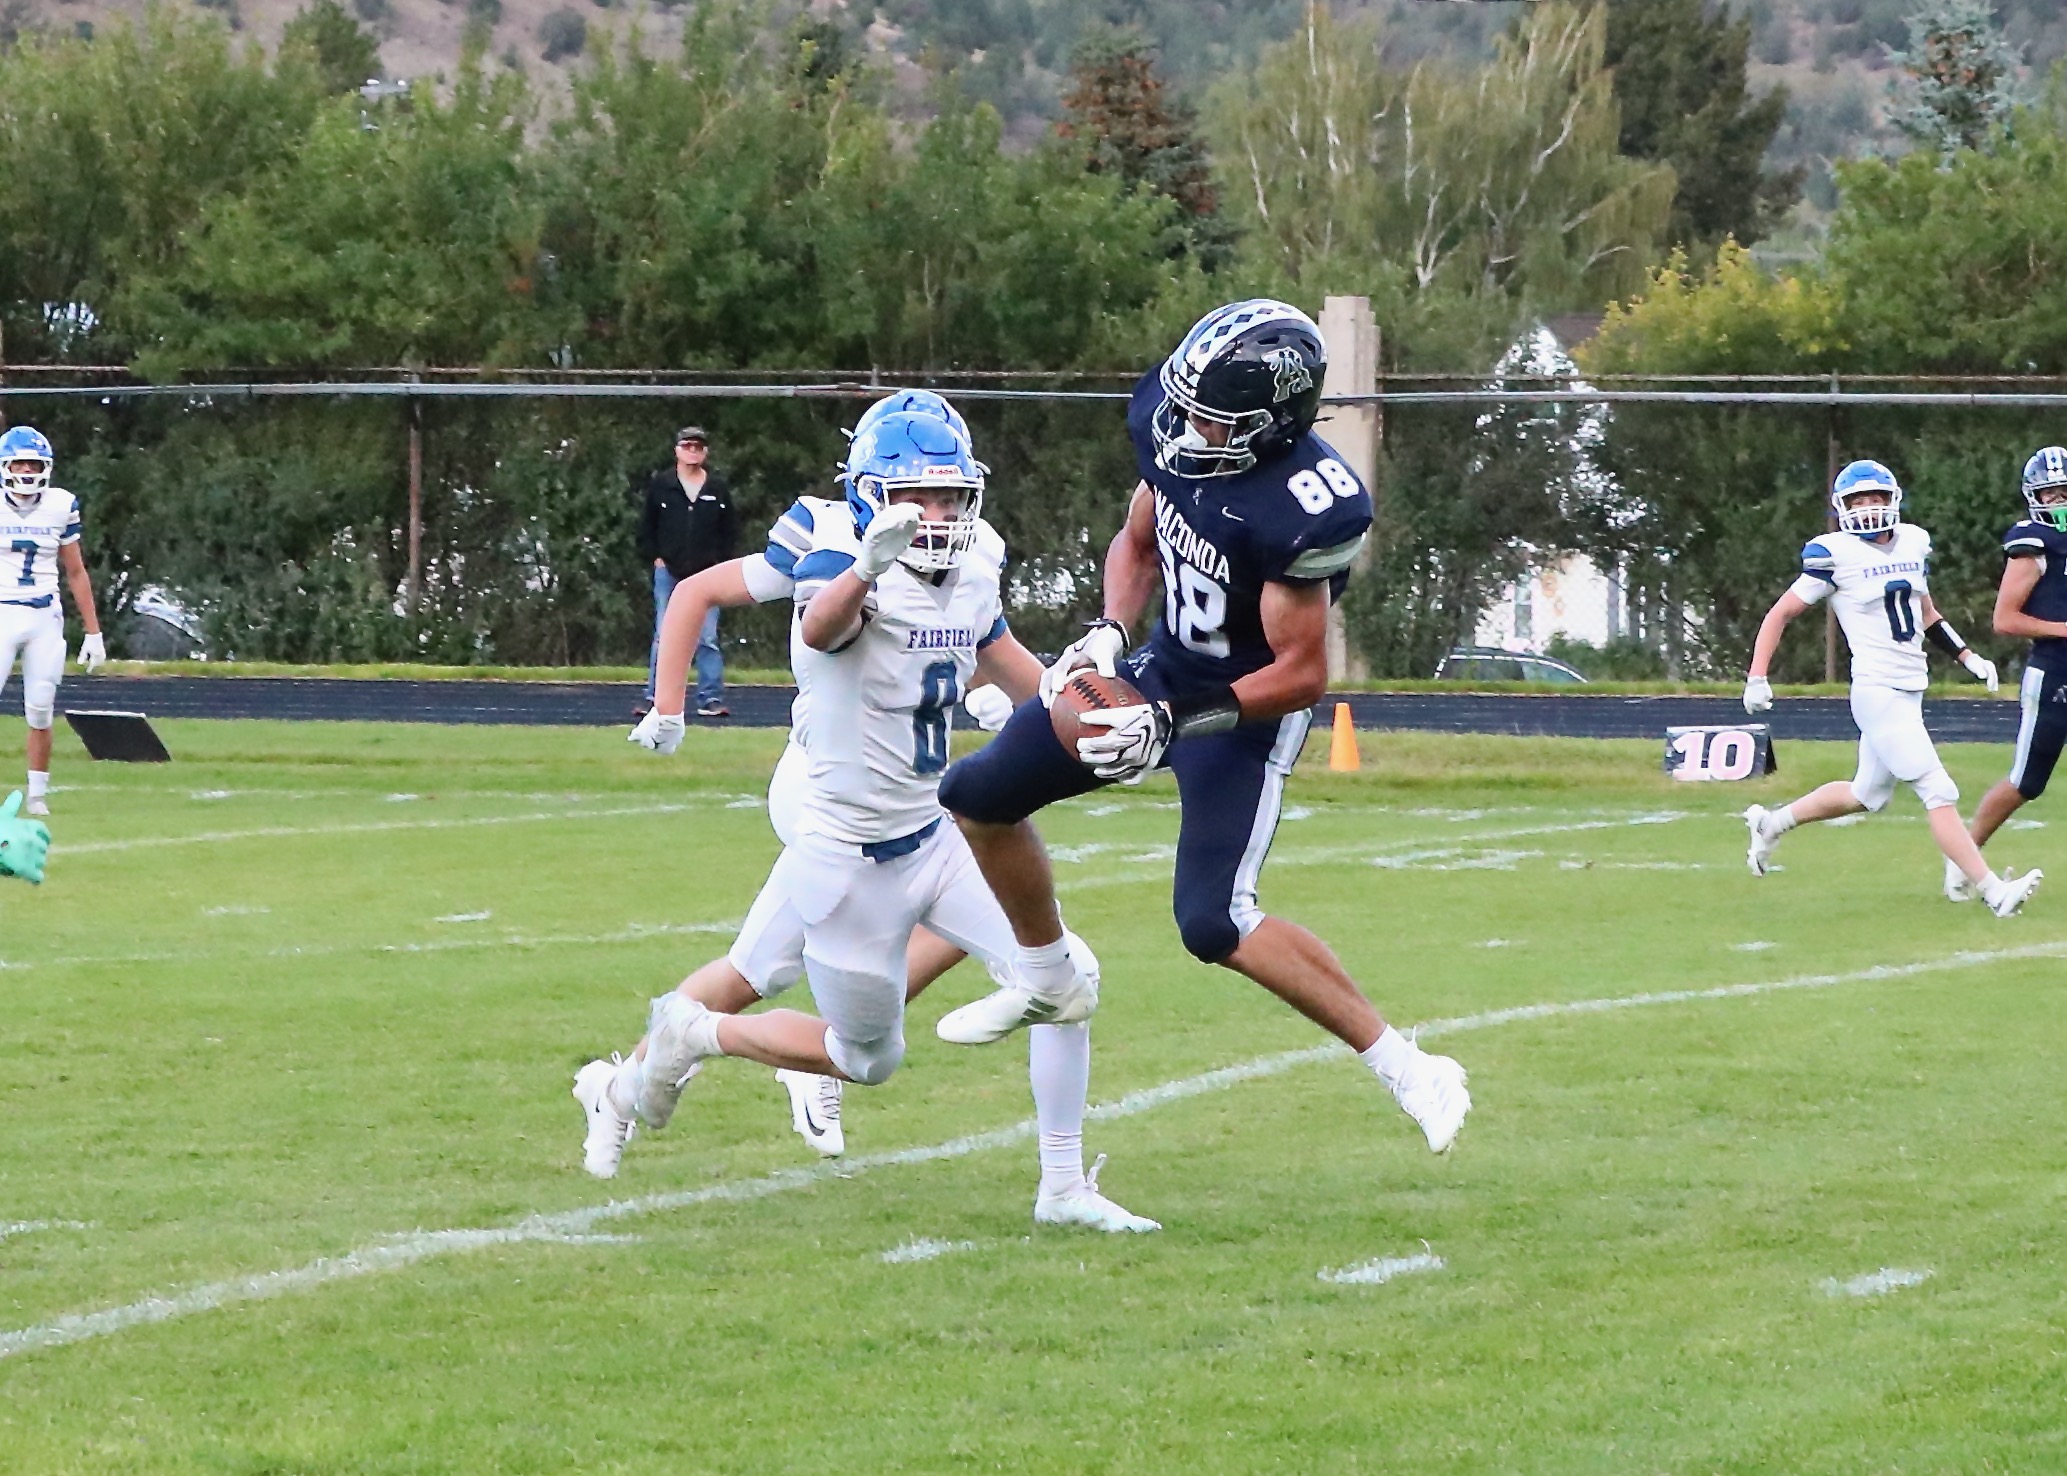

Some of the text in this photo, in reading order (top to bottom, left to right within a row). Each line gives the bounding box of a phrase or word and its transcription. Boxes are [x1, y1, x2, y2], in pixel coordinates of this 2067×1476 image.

[1286, 457, 1360, 516] 88
[11, 540, 41, 587] 7
[906, 627, 975, 649] FAIRFIEL
[1883, 579, 1916, 643] 0
[912, 660, 957, 775] 8
[1671, 730, 1756, 781] 10
